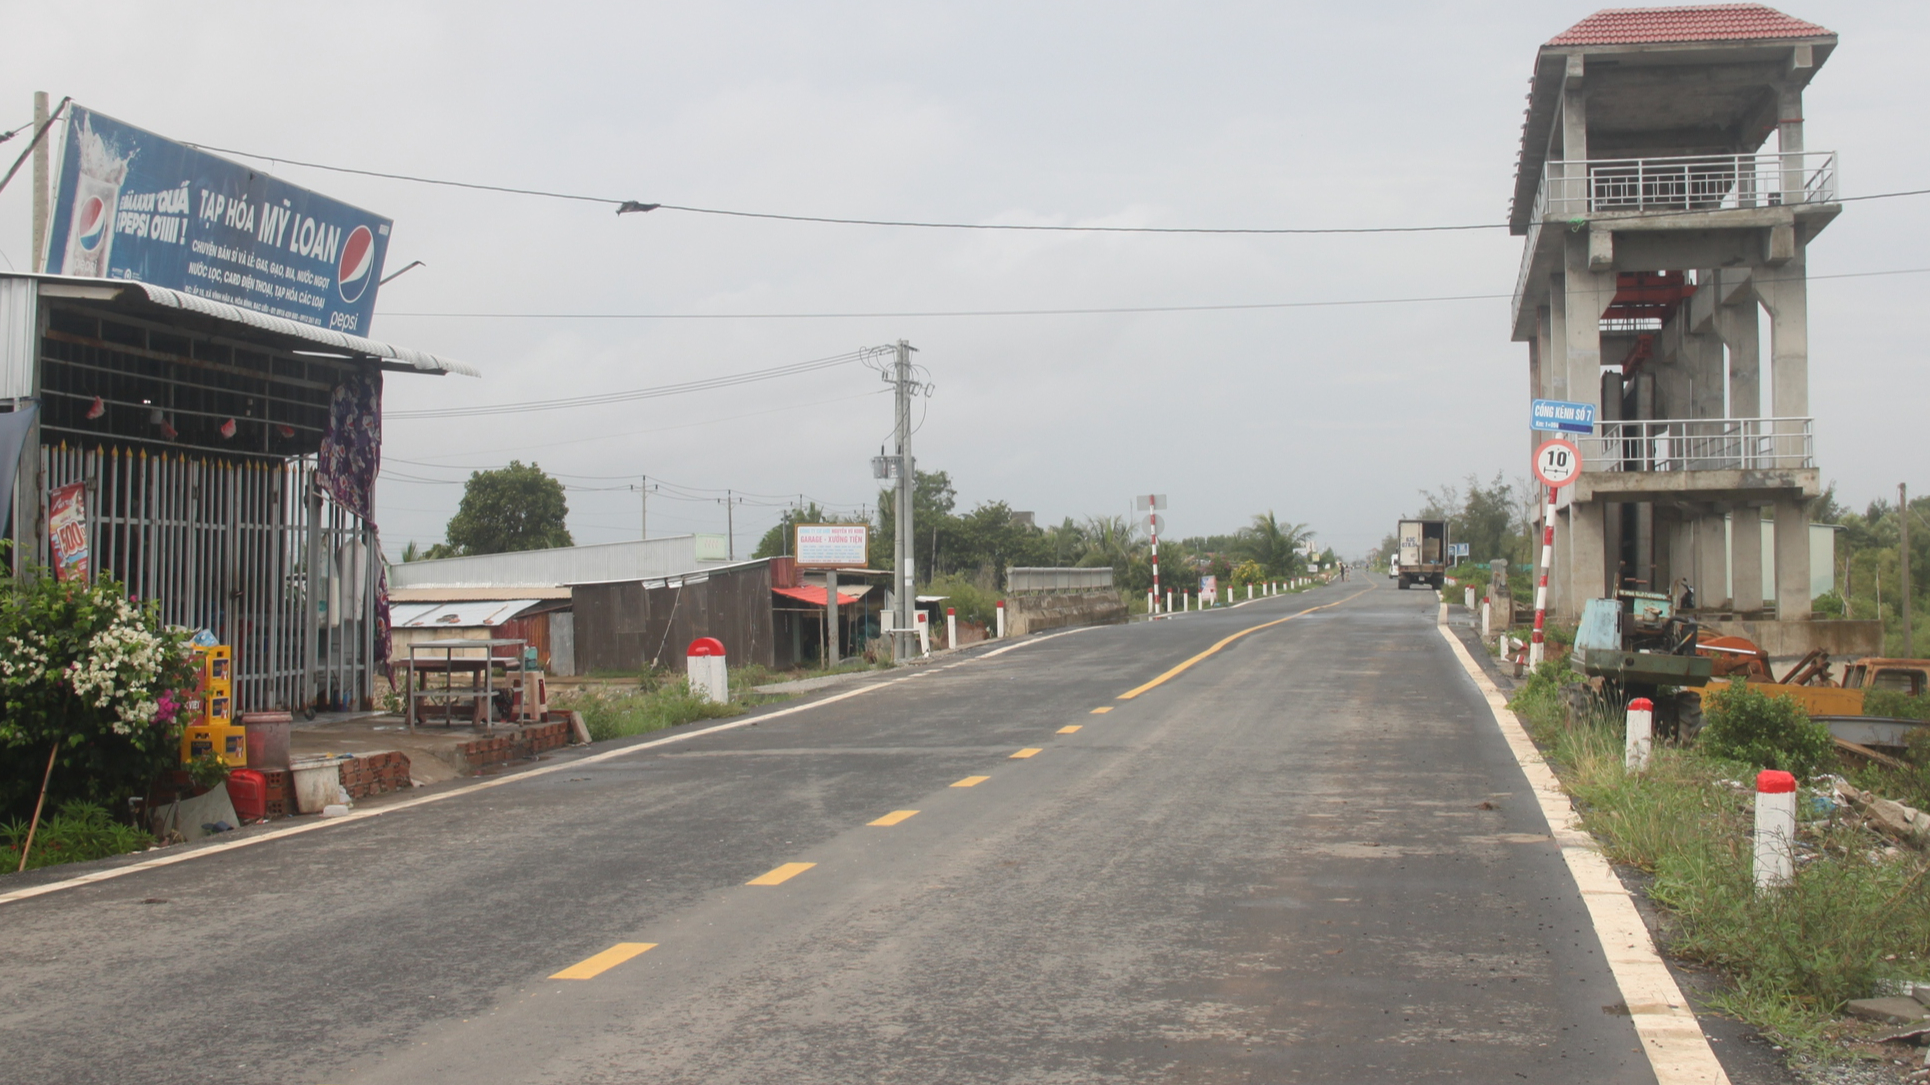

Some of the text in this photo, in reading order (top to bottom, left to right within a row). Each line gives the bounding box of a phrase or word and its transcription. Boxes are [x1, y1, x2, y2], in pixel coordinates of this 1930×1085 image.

[116, 211, 151, 238] PEPSI
[200, 188, 255, 234] TẠP HÓA
[258, 198, 341, 265] MỸ LOAN
[192, 239, 218, 258] CHUYÊN
[217, 244, 231, 261] BÁN
[238, 250, 247, 266] VÀ
[255, 257, 269, 275] GAS,
[270, 261, 284, 279] GẠO,
[314, 274, 331, 292] NGỌT
[188, 261, 208, 278] NƯỚC
[208, 266, 222, 284] LỌC,
[223, 271, 241, 286] CARD
[241, 273, 255, 292] ĐIỆN
[274, 284, 286, 301] TẠP
[285, 286, 298, 302] HÓA
[299, 290, 312, 306] CÁC
[312, 295, 326, 311] LOẠI
[329, 311, 359, 332] pepsi
[1534, 401, 1592, 422] CỐNG KÊNH SỐ 7
[801, 535, 822, 543] GARAGE
